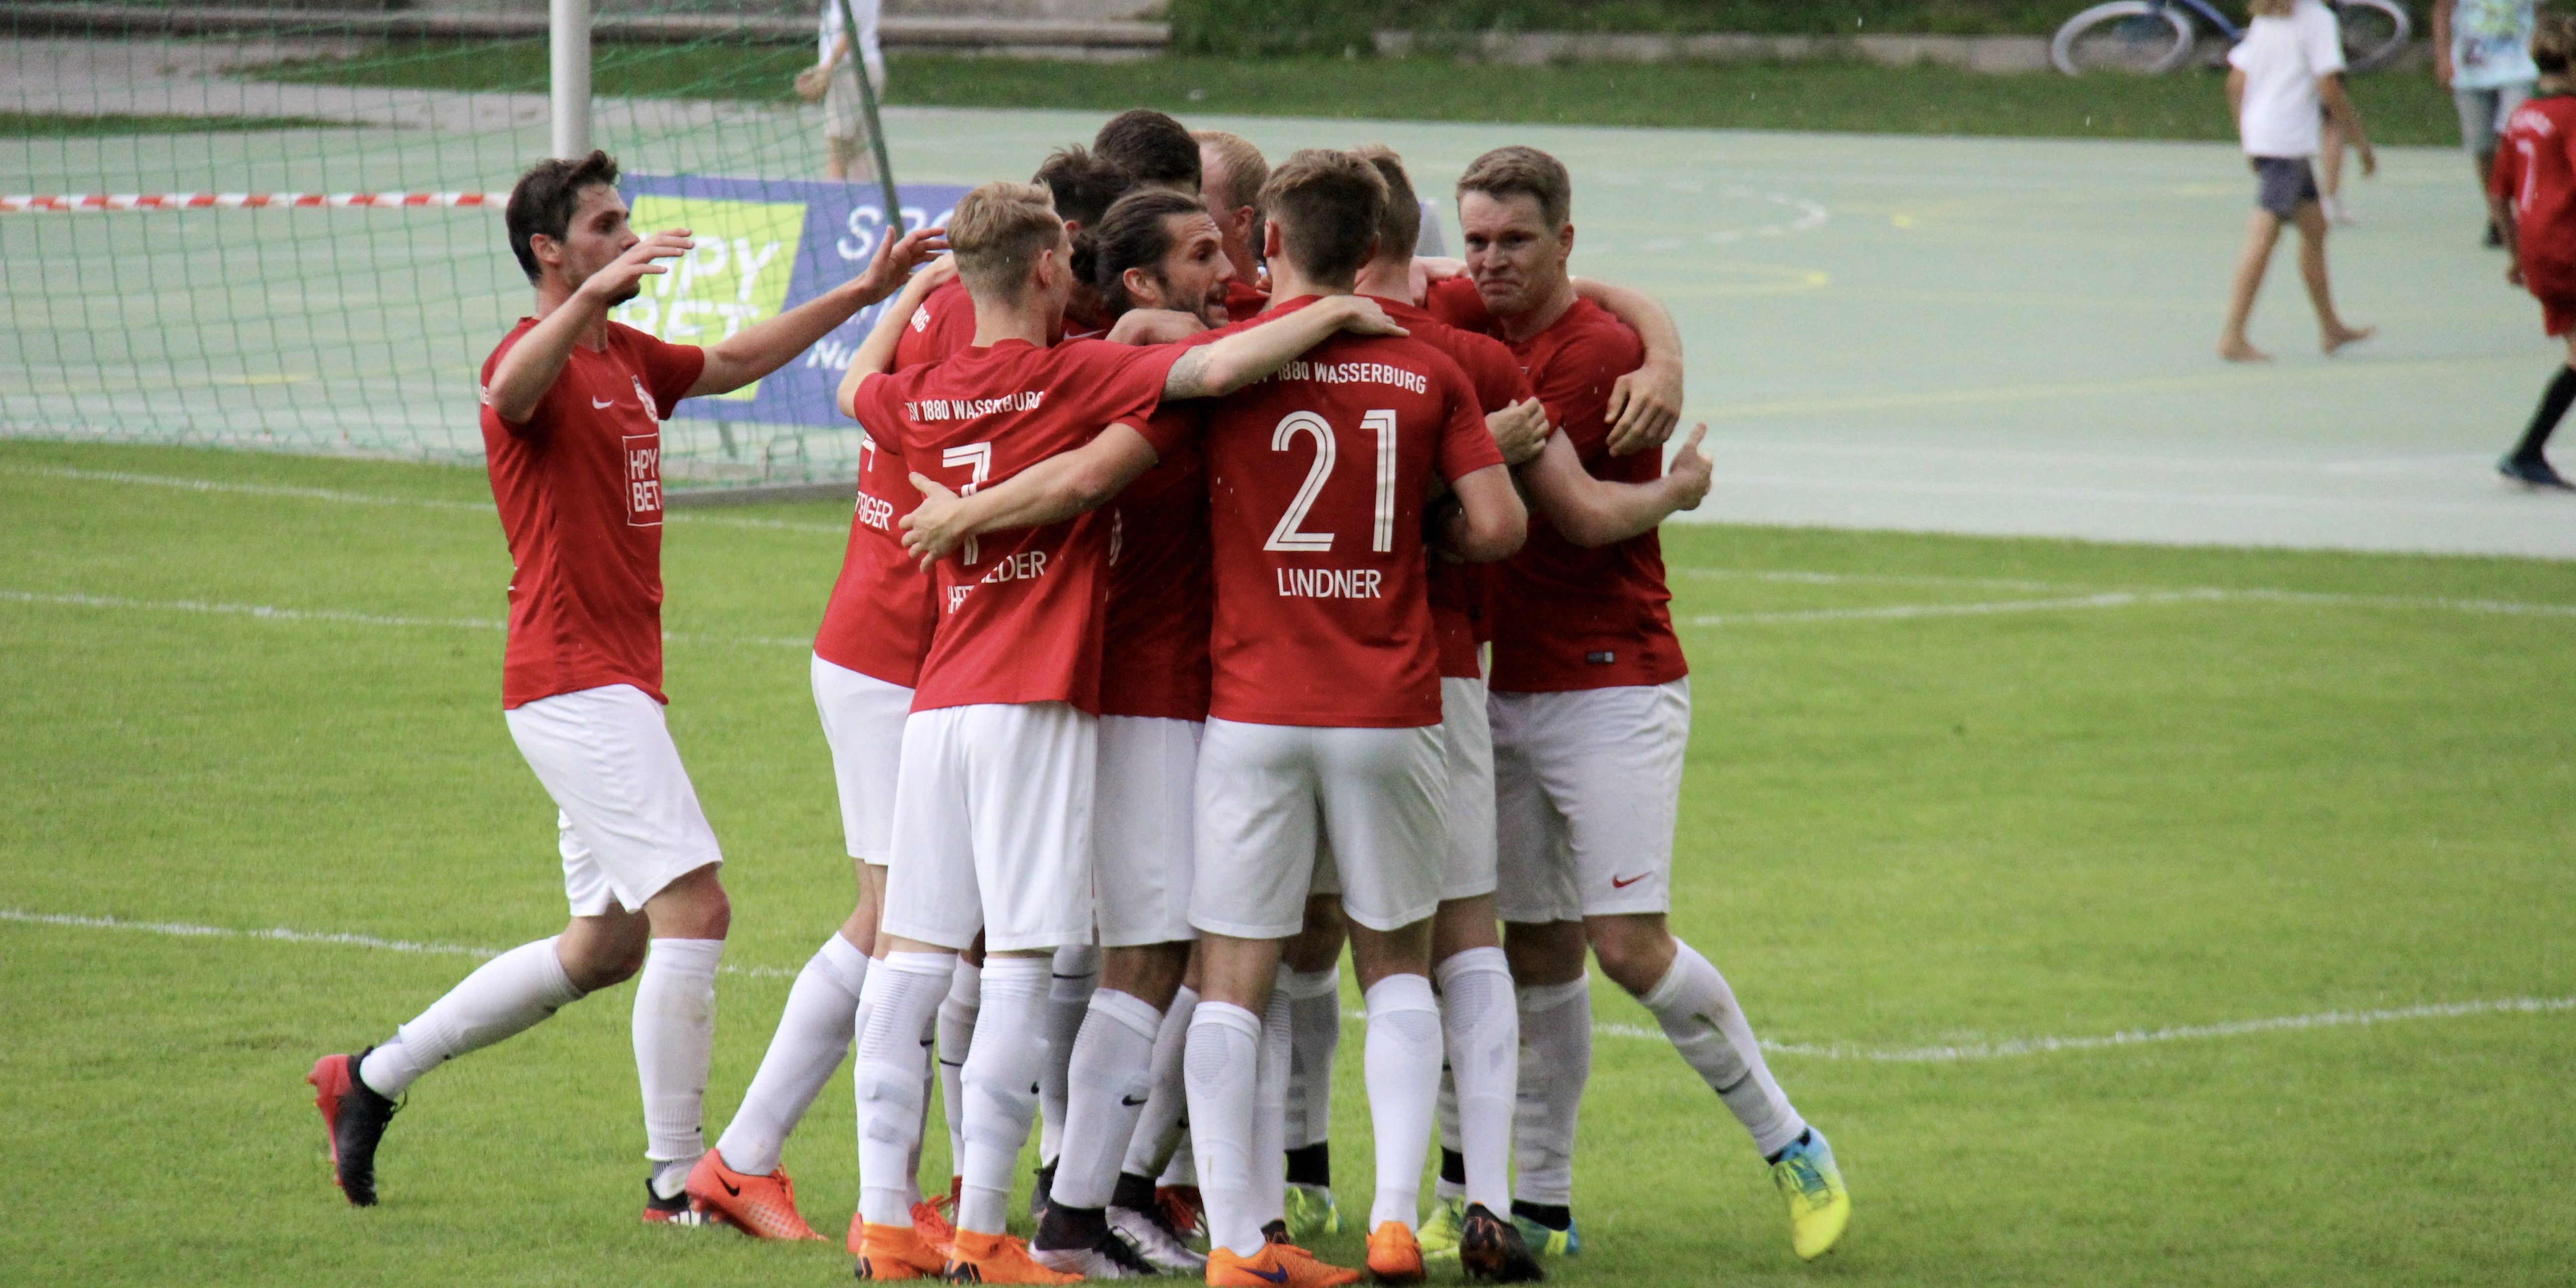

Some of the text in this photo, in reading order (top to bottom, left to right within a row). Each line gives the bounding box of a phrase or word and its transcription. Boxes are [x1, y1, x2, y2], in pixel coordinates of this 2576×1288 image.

[1314, 362, 1426, 394] WASSERBURG
[920, 399, 950, 421] 1880
[630, 448, 657, 480] HPY
[632, 480, 660, 512] BET
[1263, 409, 1397, 553] 21
[1277, 567, 1381, 598] LINDNER
